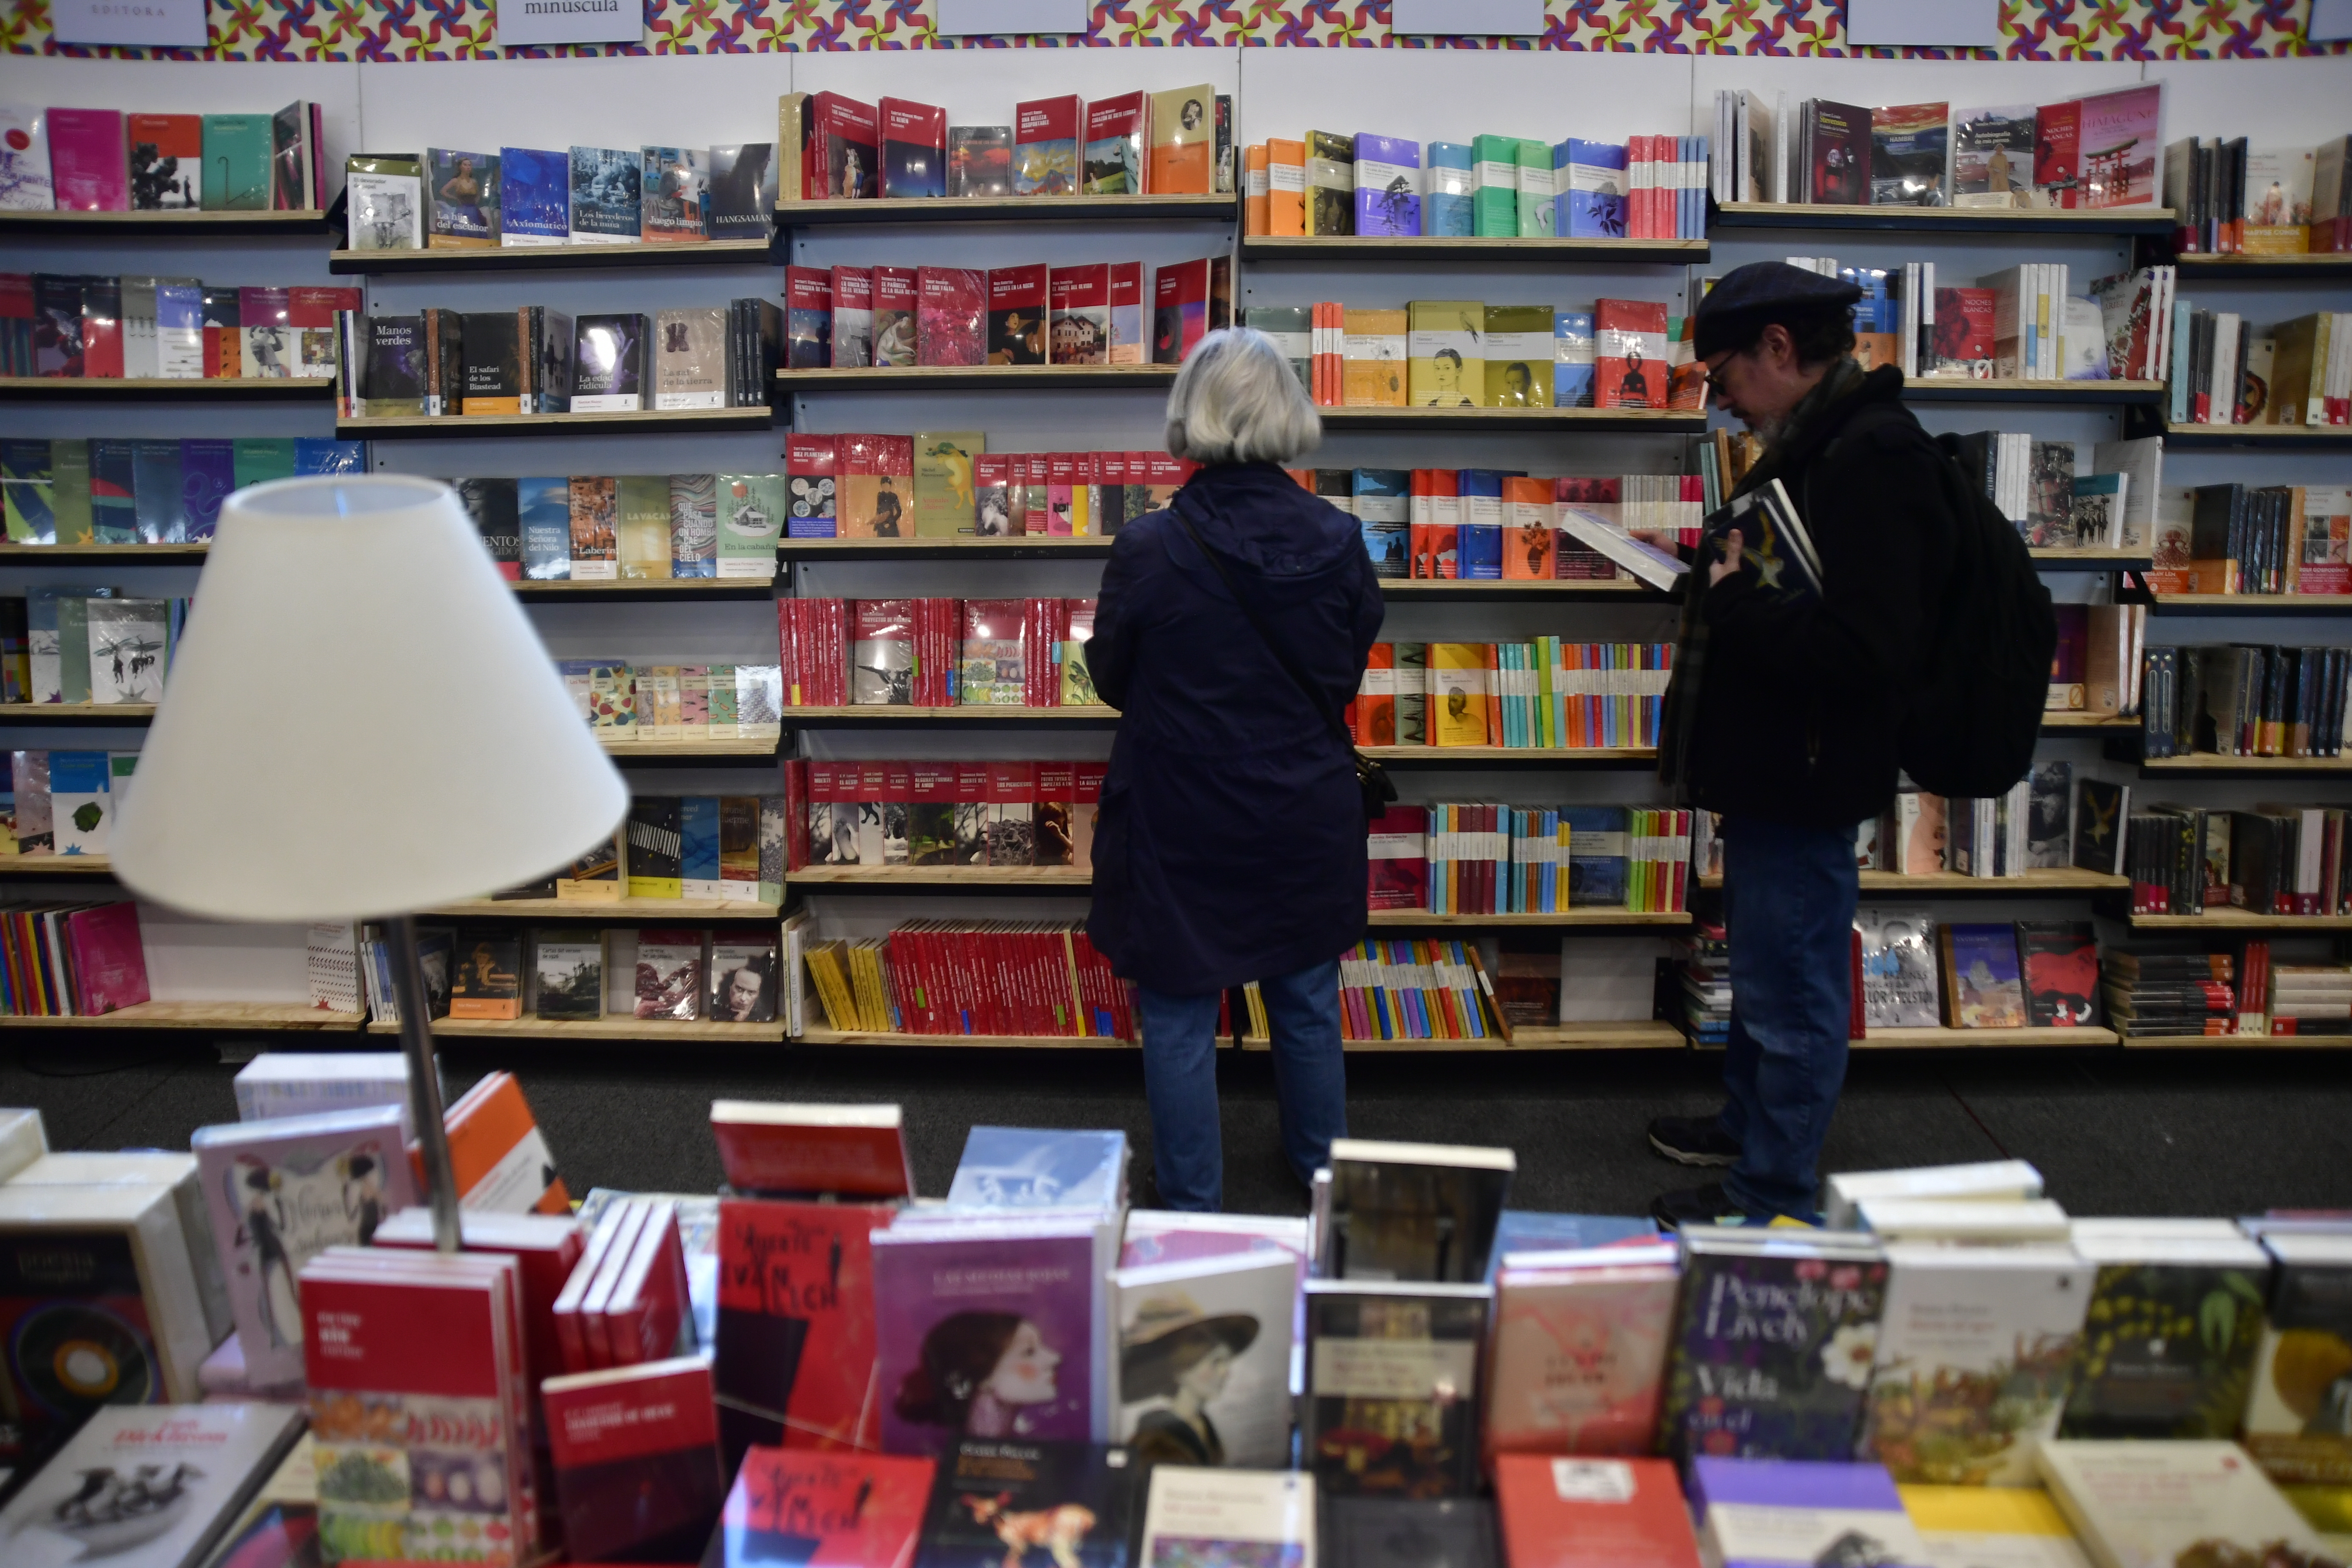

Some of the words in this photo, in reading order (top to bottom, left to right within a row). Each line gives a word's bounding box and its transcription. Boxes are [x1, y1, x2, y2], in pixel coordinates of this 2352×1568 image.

[92, 4, 166, 16] EDITORA
[1819, 115, 1848, 128] Stevenson
[2046, 125, 2074, 134] NOCHES
[1889, 134, 1916, 143] HAMBRE
[437, 212, 446, 220] La
[579, 210, 593, 218] Los
[596, 211, 634, 221] herederos
[716, 213, 772, 223] HANGSAMAN
[648, 215, 675, 226] Juego
[676, 216, 703, 228] limpio
[437, 220, 451, 229] del
[453, 223, 488, 233] escultor
[376, 325, 411, 335] Manos
[375, 335, 411, 345] verdes
[469, 382, 501, 390] Binstead
[579, 382, 612, 390] ridícula
[683, 511, 702, 519] PASA
[683, 519, 713, 528] CUANDO
[528, 526, 561, 534] Nuestra
[678, 528, 689, 536] UN
[528, 534, 556, 542] Señora
[683, 536, 698, 544] CAE
[679, 545, 693, 553] DEL
[679, 553, 701, 562] CIELO
